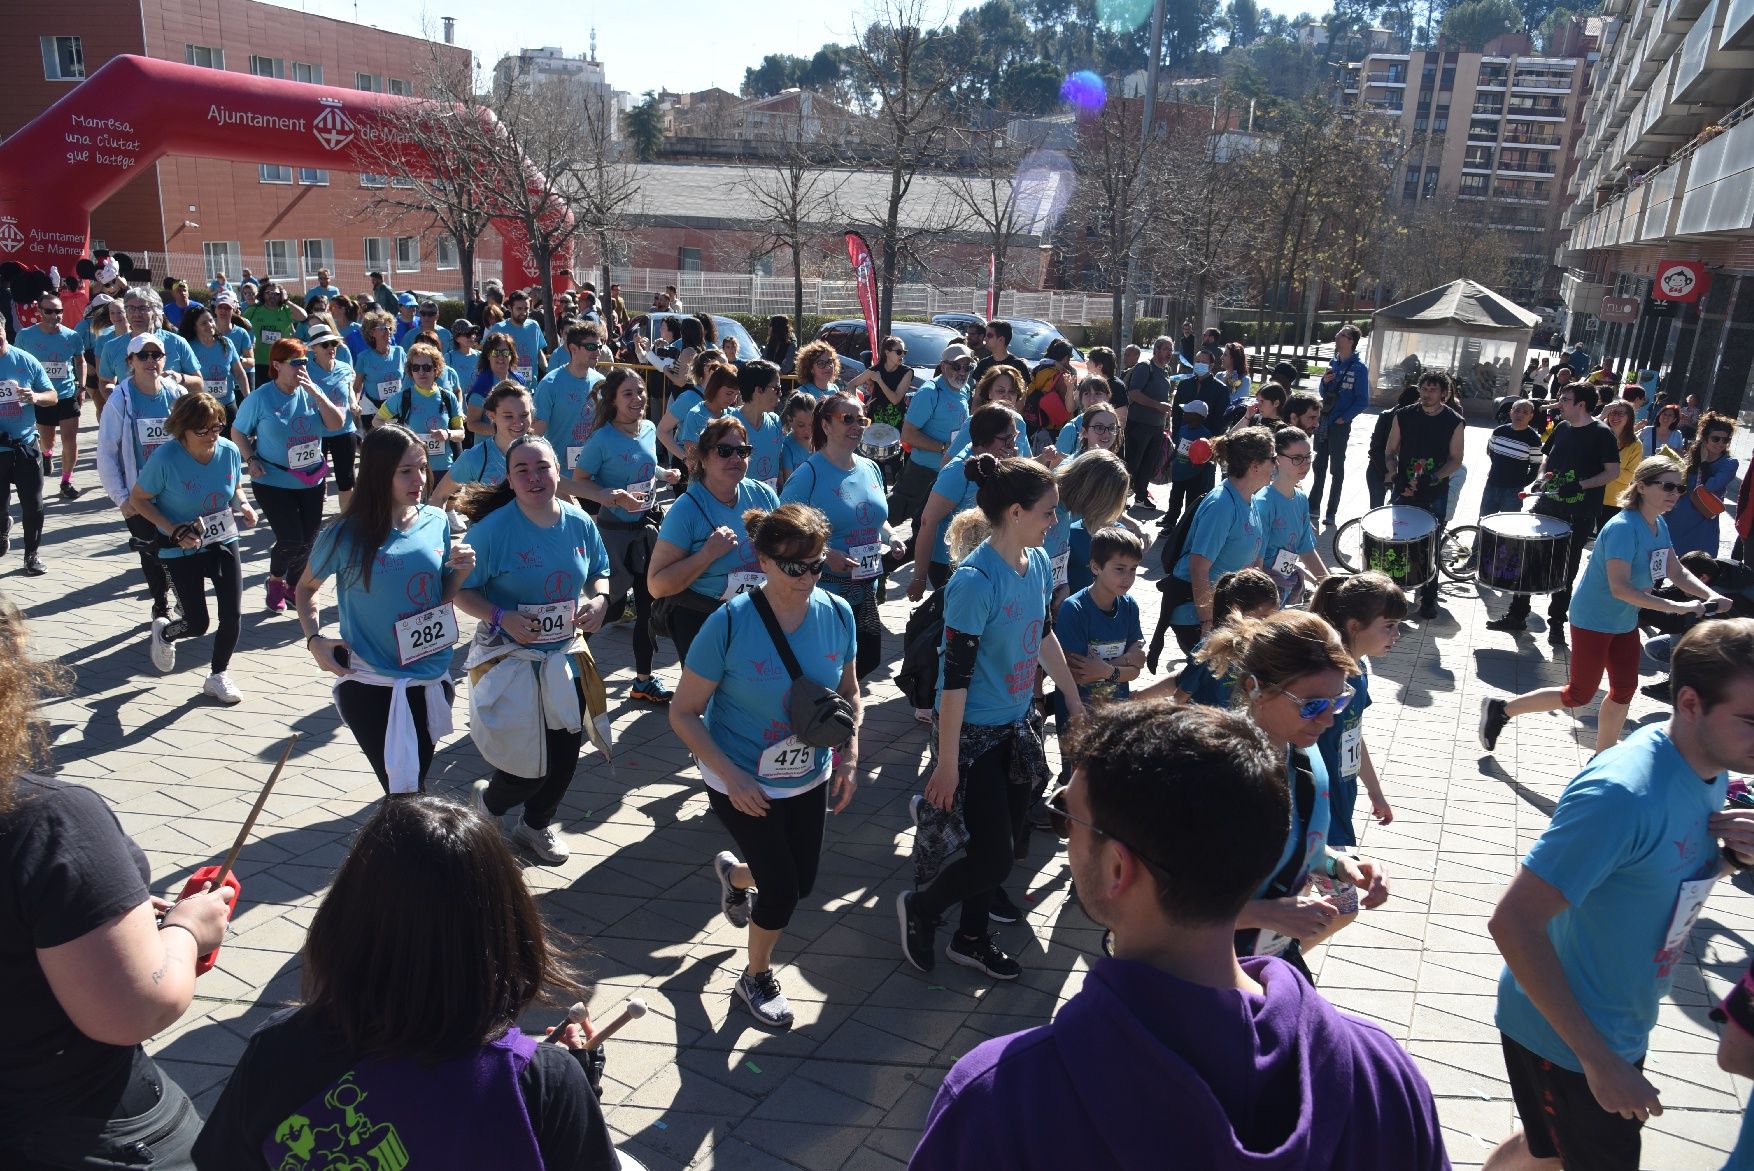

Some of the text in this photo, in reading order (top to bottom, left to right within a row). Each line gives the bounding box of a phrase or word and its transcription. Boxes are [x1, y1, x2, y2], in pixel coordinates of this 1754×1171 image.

[71, 114, 134, 133] Manresa,
[207, 104, 306, 132] Ajuntament
[360, 124, 378, 140] de
[65, 132, 141, 151] una ciutat
[66, 150, 135, 169] que batega
[29, 228, 86, 243] Ajuntament
[29, 242, 45, 253] de
[46, 367, 62, 375] 207
[208, 385, 223, 394] 383
[296, 449, 315, 462] 726
[203, 521, 226, 539] 281
[410, 621, 445, 649] 282
[774, 745, 810, 766] 475
